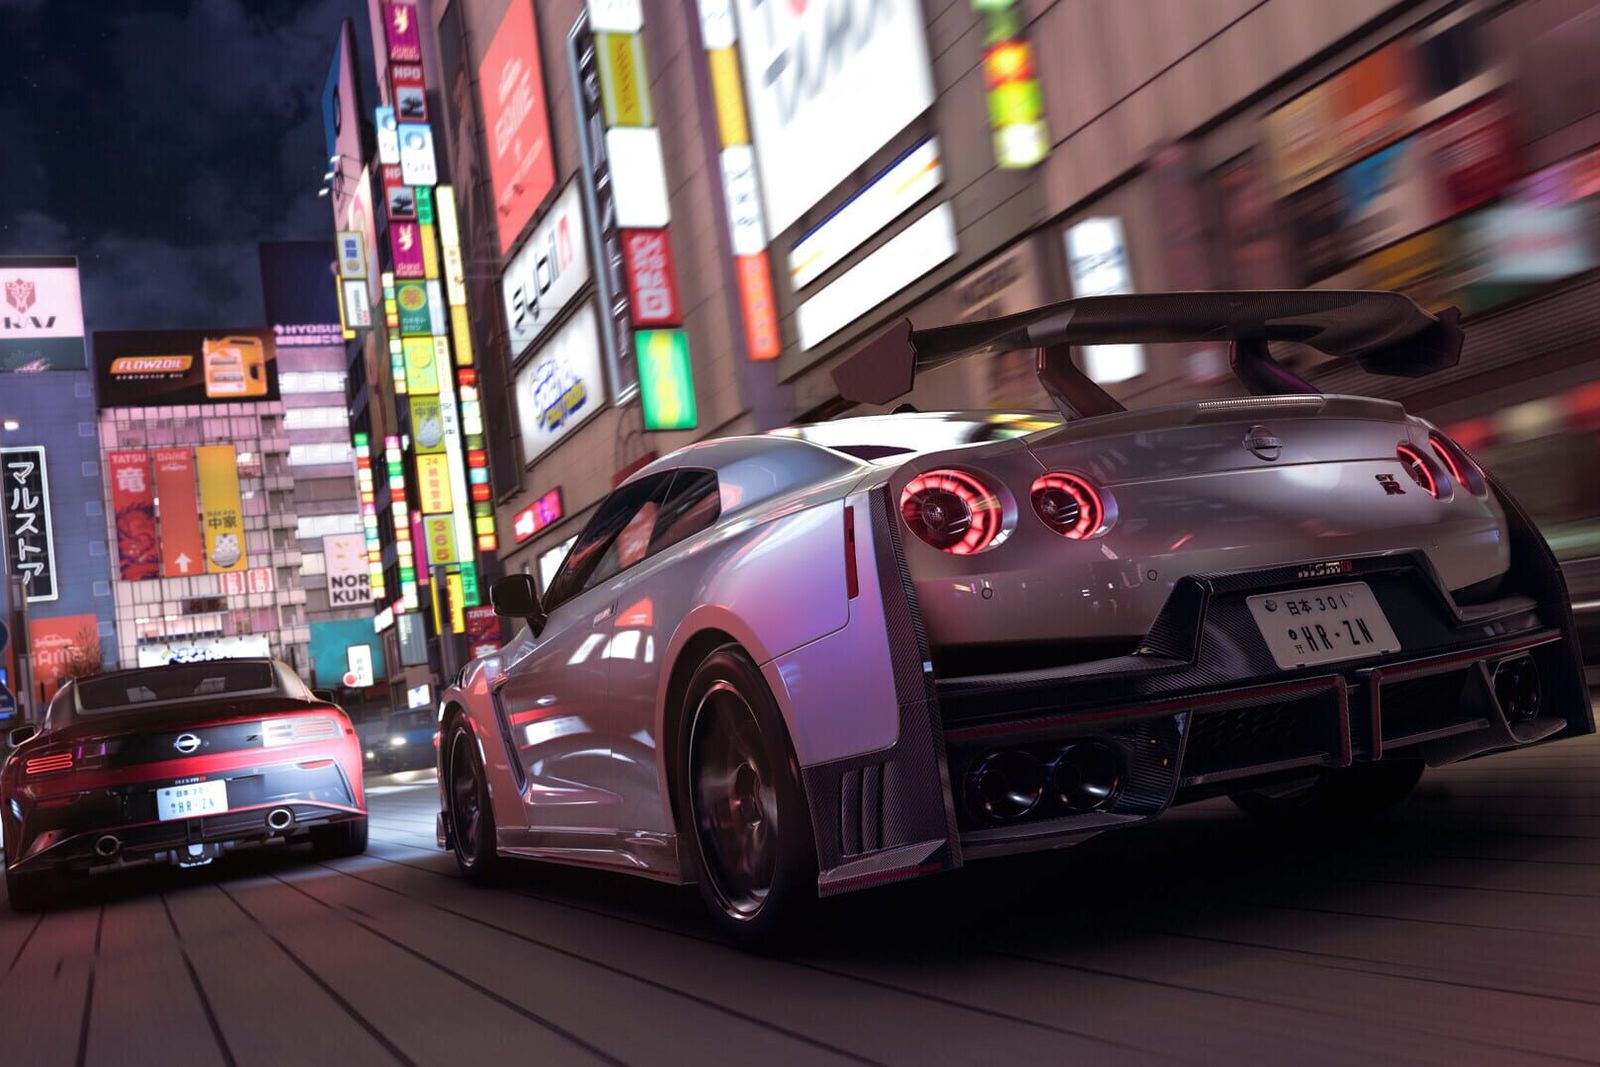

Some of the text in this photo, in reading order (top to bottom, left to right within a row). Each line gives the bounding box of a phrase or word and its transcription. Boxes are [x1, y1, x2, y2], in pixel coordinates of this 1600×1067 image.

[111, 452, 147, 465] TATSU
[8, 461, 44, 585] マルストア
[433, 519, 450, 561] 365
[331, 574, 369, 589] NOR
[333, 589, 370, 603] KUN
[1287, 595, 1347, 616] 日本 301
